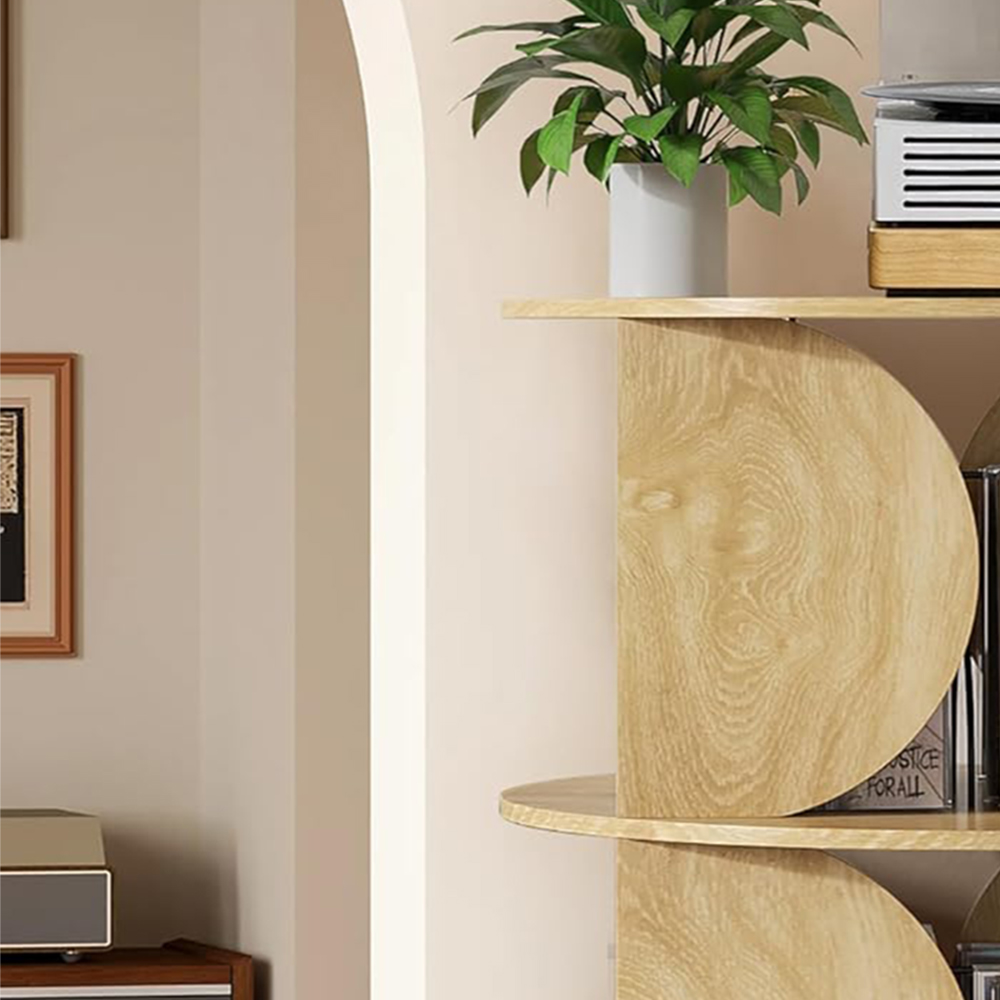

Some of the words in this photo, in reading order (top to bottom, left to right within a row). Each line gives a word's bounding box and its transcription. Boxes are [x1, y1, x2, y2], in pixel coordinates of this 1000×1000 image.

[889, 745, 940, 770] USTICE
[867, 776, 896, 798] FOR
[897, 775, 925, 798] ALL
